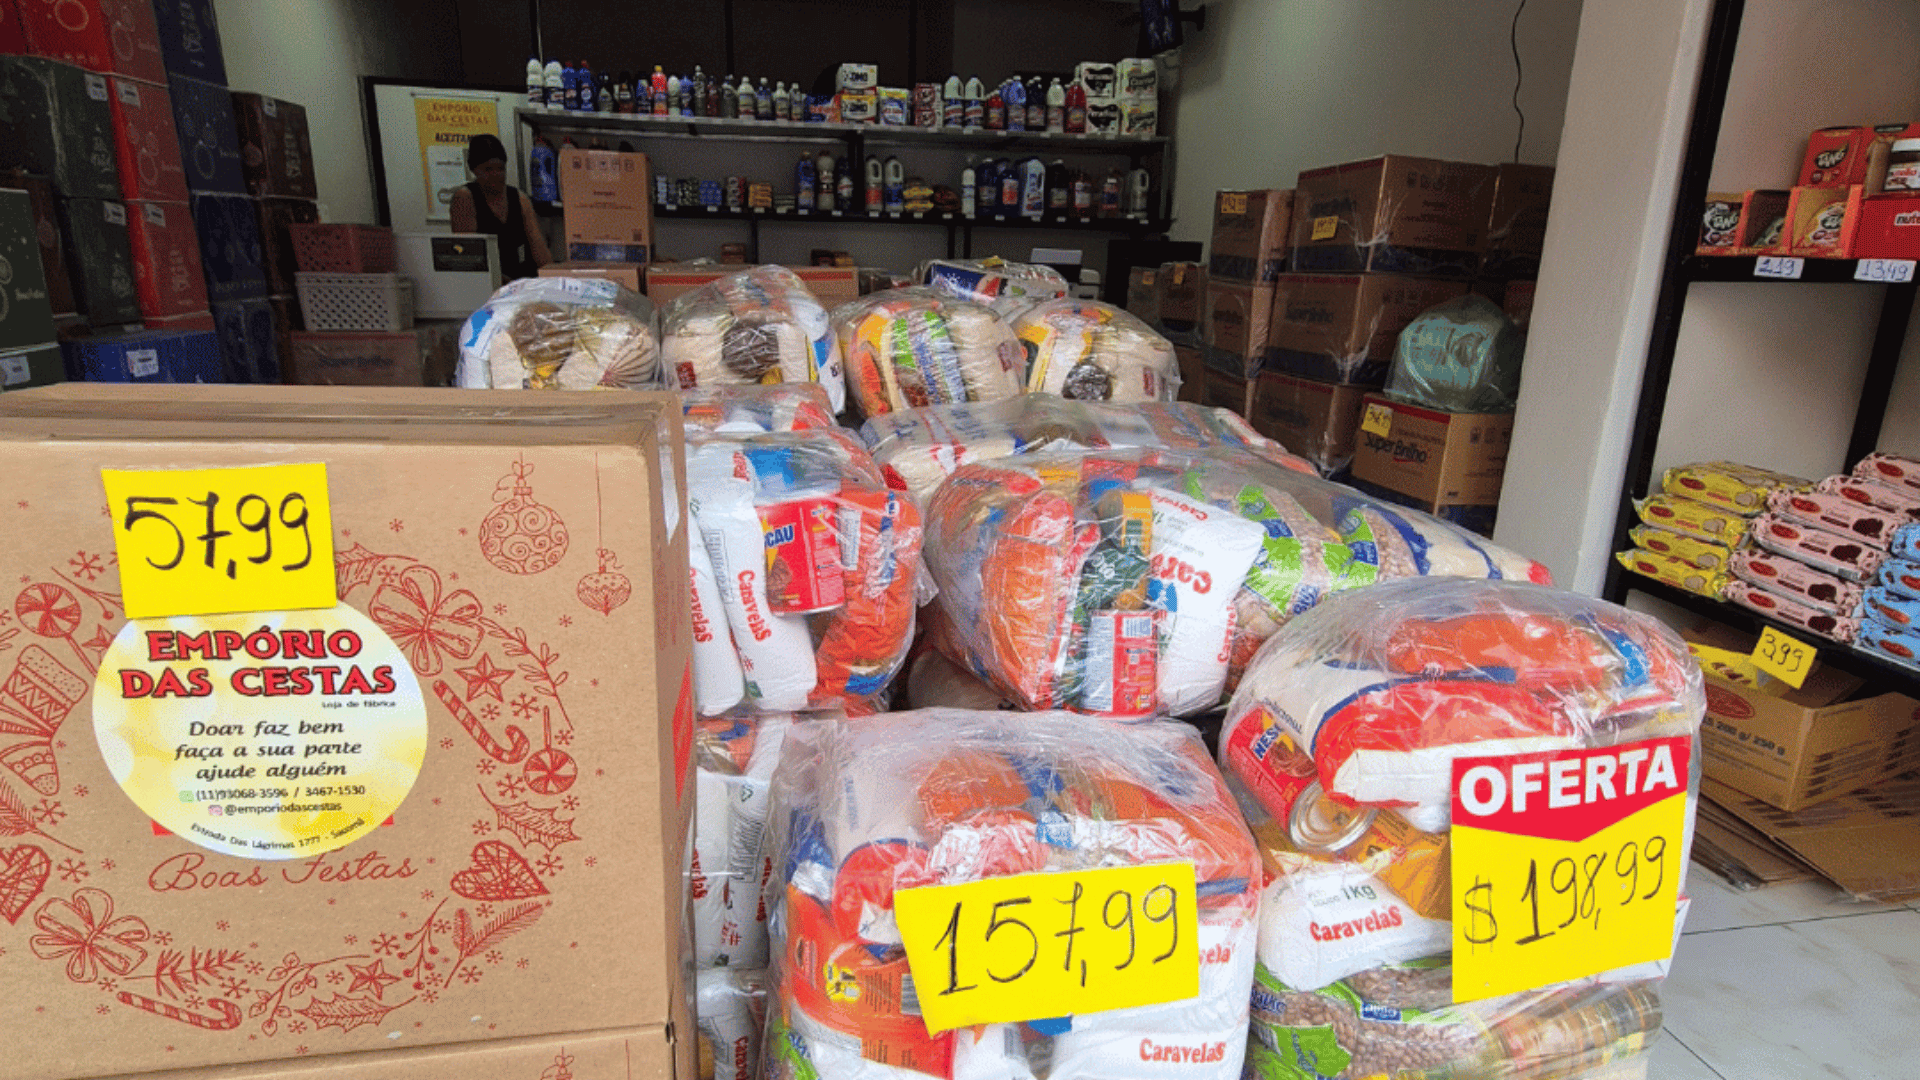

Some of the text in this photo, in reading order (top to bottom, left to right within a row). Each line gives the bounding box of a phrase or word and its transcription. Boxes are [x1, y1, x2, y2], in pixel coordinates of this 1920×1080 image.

[1364, 431, 1428, 463] Super Brilho
[124, 490, 312, 580] 57,99
[145, 625, 363, 661] EMPÓRIO
[118, 665, 397, 699] DAS CESTAS
[189, 719, 345, 737] Doar faz bem
[173, 741, 362, 761] faça a sua parte
[195, 762, 347, 782] ajude alguém
[1459, 744, 1678, 818] OFERTA
[224, 801, 342, 816] @emporiodascestas
[230, 834, 248, 849] Das
[148, 850, 420, 893] Boas Festas
[1463, 834, 1667, 957] $ 198,99
[932, 881, 1179, 997] 157,99
